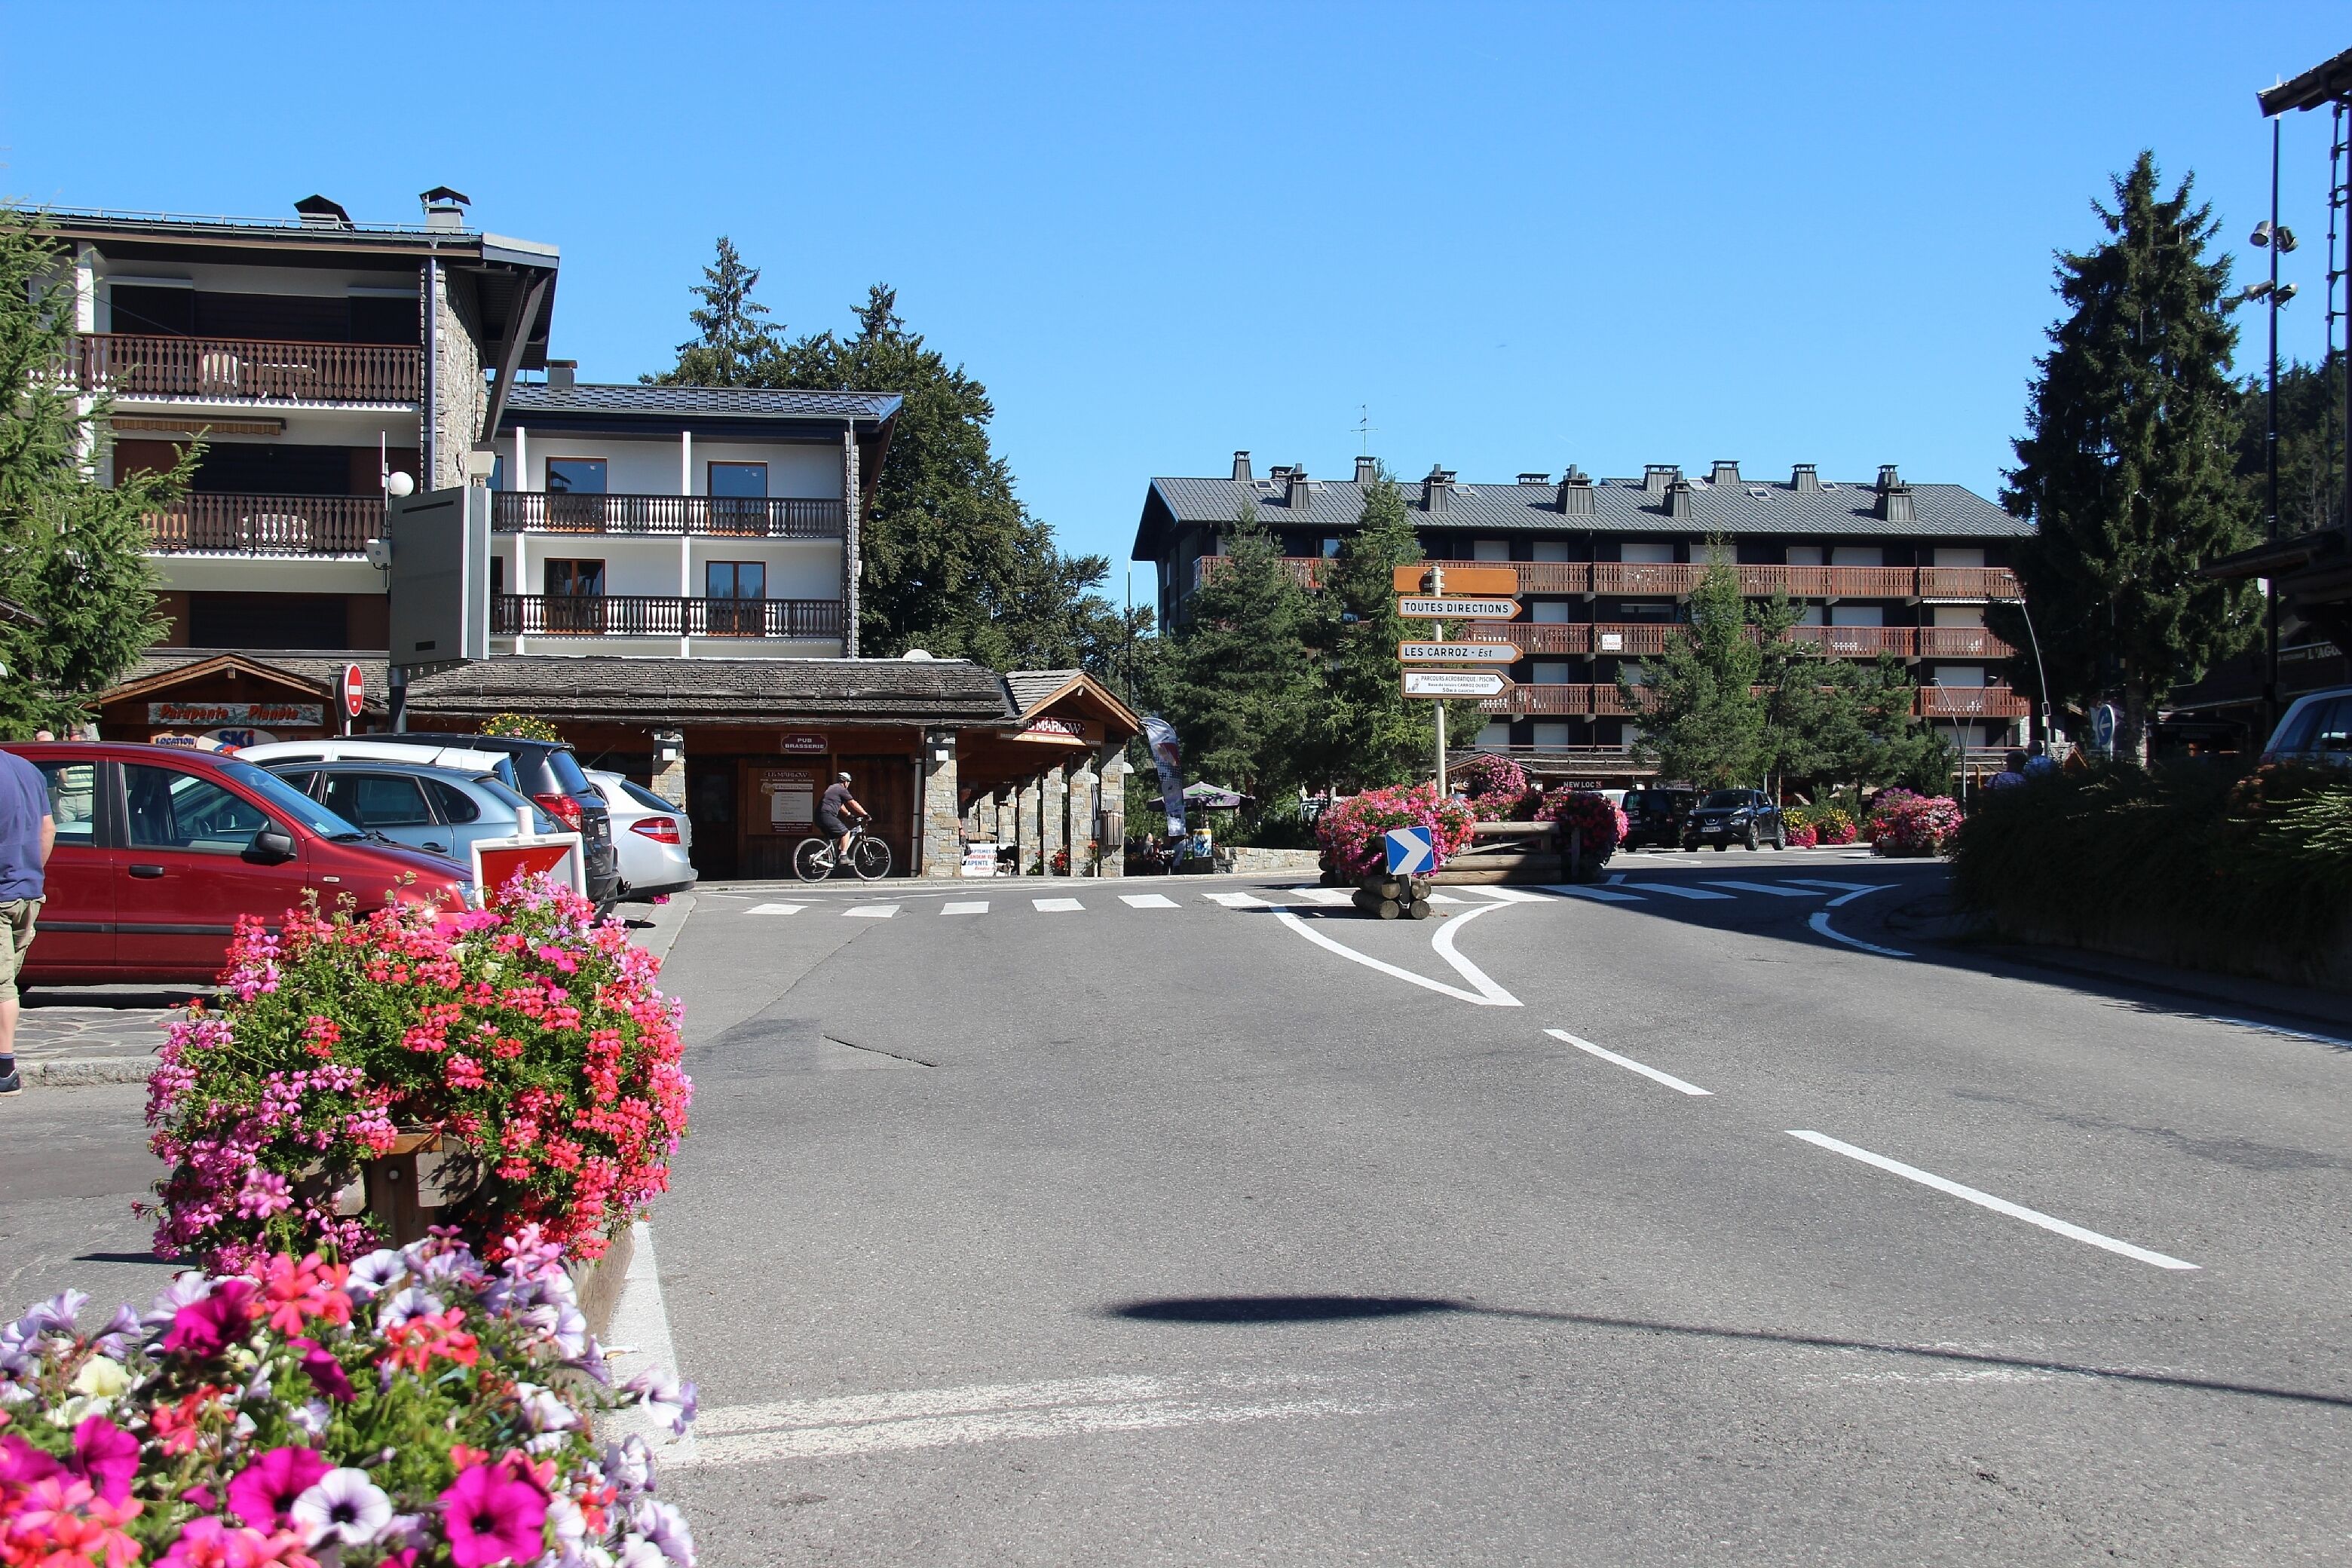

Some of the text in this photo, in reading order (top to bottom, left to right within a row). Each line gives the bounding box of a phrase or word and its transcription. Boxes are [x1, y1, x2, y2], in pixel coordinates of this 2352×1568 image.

[1404, 602, 1508, 613] TOUTES DIRECTIONS
[1404, 647, 1423, 657] LES
[1427, 648, 1468, 657] CARROZ
[1478, 648, 1493, 657] Est
[160, 704, 229, 724] Parapente
[1036, 719, 1081, 734] MARLOW
[155, 737, 194, 746] LOCATION
